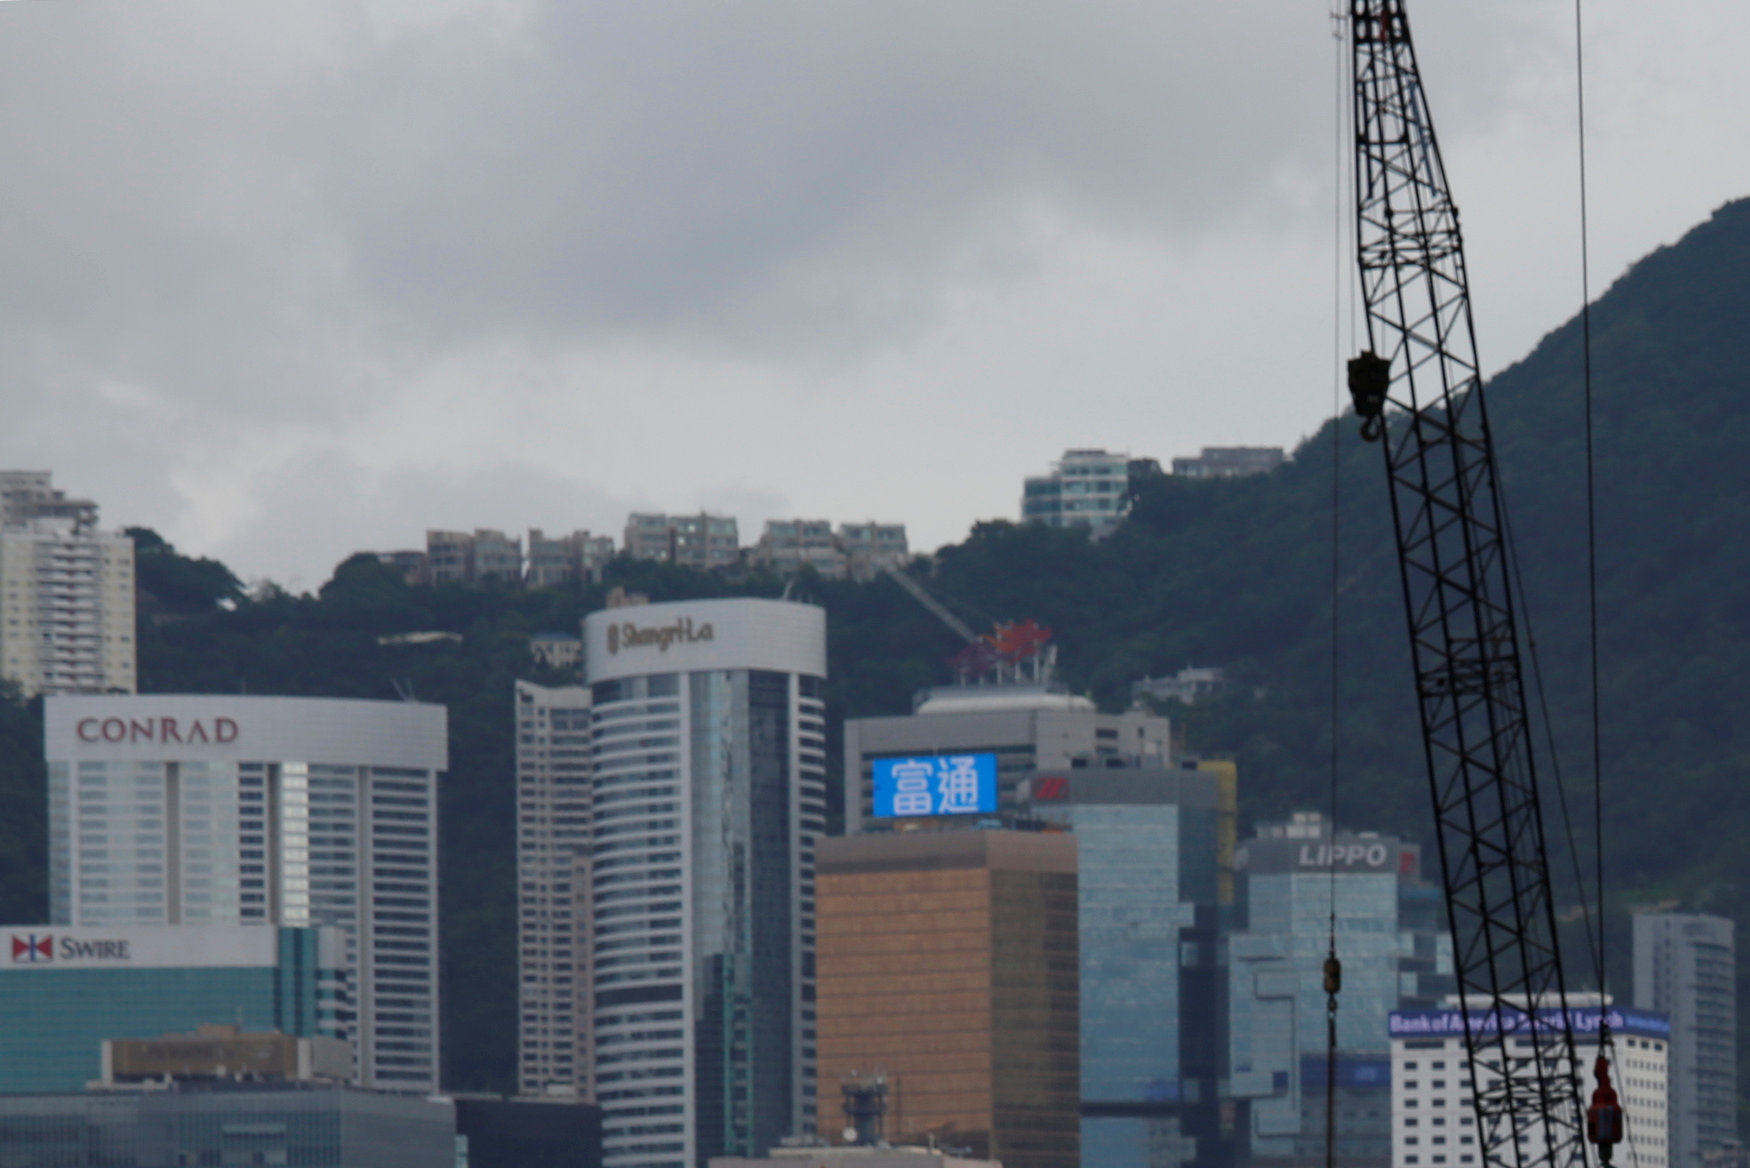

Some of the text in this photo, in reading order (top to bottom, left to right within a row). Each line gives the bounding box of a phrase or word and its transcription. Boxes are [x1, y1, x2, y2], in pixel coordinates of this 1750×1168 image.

[622, 616, 714, 651] Shangri-La
[76, 717, 239, 743] CONRAD
[891, 755, 980, 816] 富通
[1298, 843, 1388, 868] LIPPO
[1390, 1013, 1430, 1033] Bank
[1431, 1013, 1449, 1032] of
[1449, 1012, 1516, 1032] Ameria
[1575, 1010, 1624, 1032] Lynch
